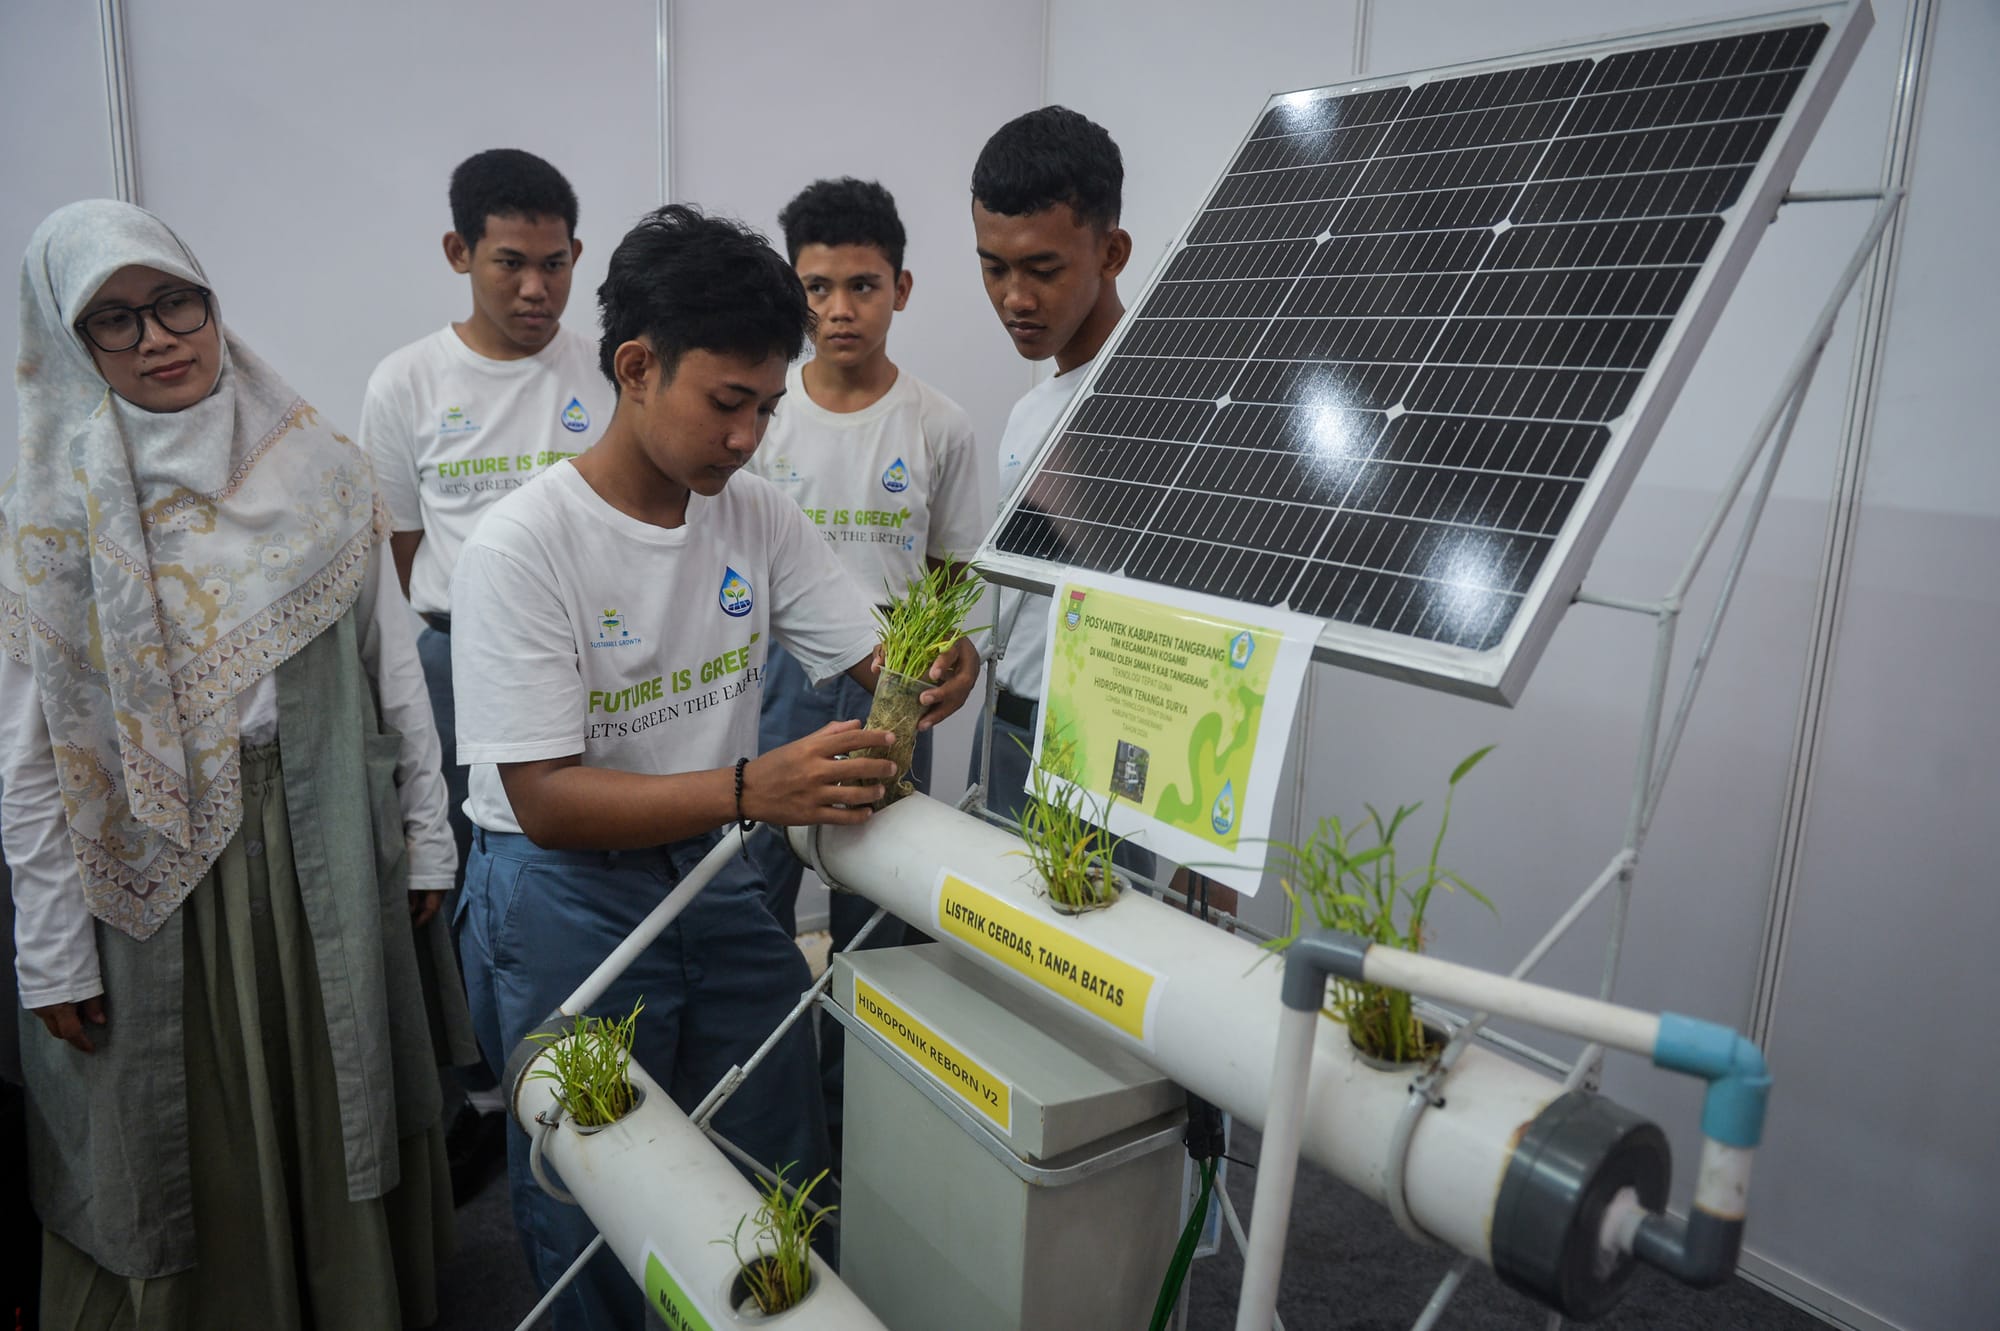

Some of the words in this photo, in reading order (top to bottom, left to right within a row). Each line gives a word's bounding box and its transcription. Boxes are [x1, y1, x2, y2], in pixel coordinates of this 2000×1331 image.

[438, 456, 510, 478] FUTURE
[516, 455, 532, 472] IS
[474, 477, 523, 492] GREEN
[833, 509, 849, 525] IS
[855, 509, 902, 528] GREEN
[840, 530, 867, 542] THE
[1084, 615, 1127, 637] POSYANTEK
[1128, 626, 1174, 649] KABUPATEN
[1174, 638, 1225, 662] TANGERANG
[1110, 637, 1121, 648] TIM
[1121, 640, 1159, 659] KECAMATAN
[1159, 651, 1188, 667] KOSAMBI
[588, 676, 664, 714] FUTURE
[671, 669, 692, 693] IS
[701, 646, 750, 684] GREE
[1089, 646, 1096, 656] DI
[1097, 648, 1117, 663] WAKILI
[1117, 654, 1133, 667] OLEH
[1133, 658, 1152, 674] SMAN
[1156, 665, 1169, 678] KAB
[1169, 669, 1209, 689] TANGERANG
[631, 703, 680, 733] GREEN
[683, 690, 719, 715] THE
[1094, 676, 1133, 697] HIDROPONIK
[1134, 689, 1164, 707] TENANGA
[1165, 699, 1188, 715] SURYA
[945, 898, 985, 934] LISTRIK
[988, 921, 1034, 964] CERDAS,
[1039, 946, 1078, 984] TANPA
[1081, 969, 1125, 1008] BATAS
[858, 992, 928, 1054] HIDROPONIK
[930, 1044, 980, 1093] REBORN
[982, 1083, 1000, 1108] V2
[660, 1288, 680, 1327] MARI
